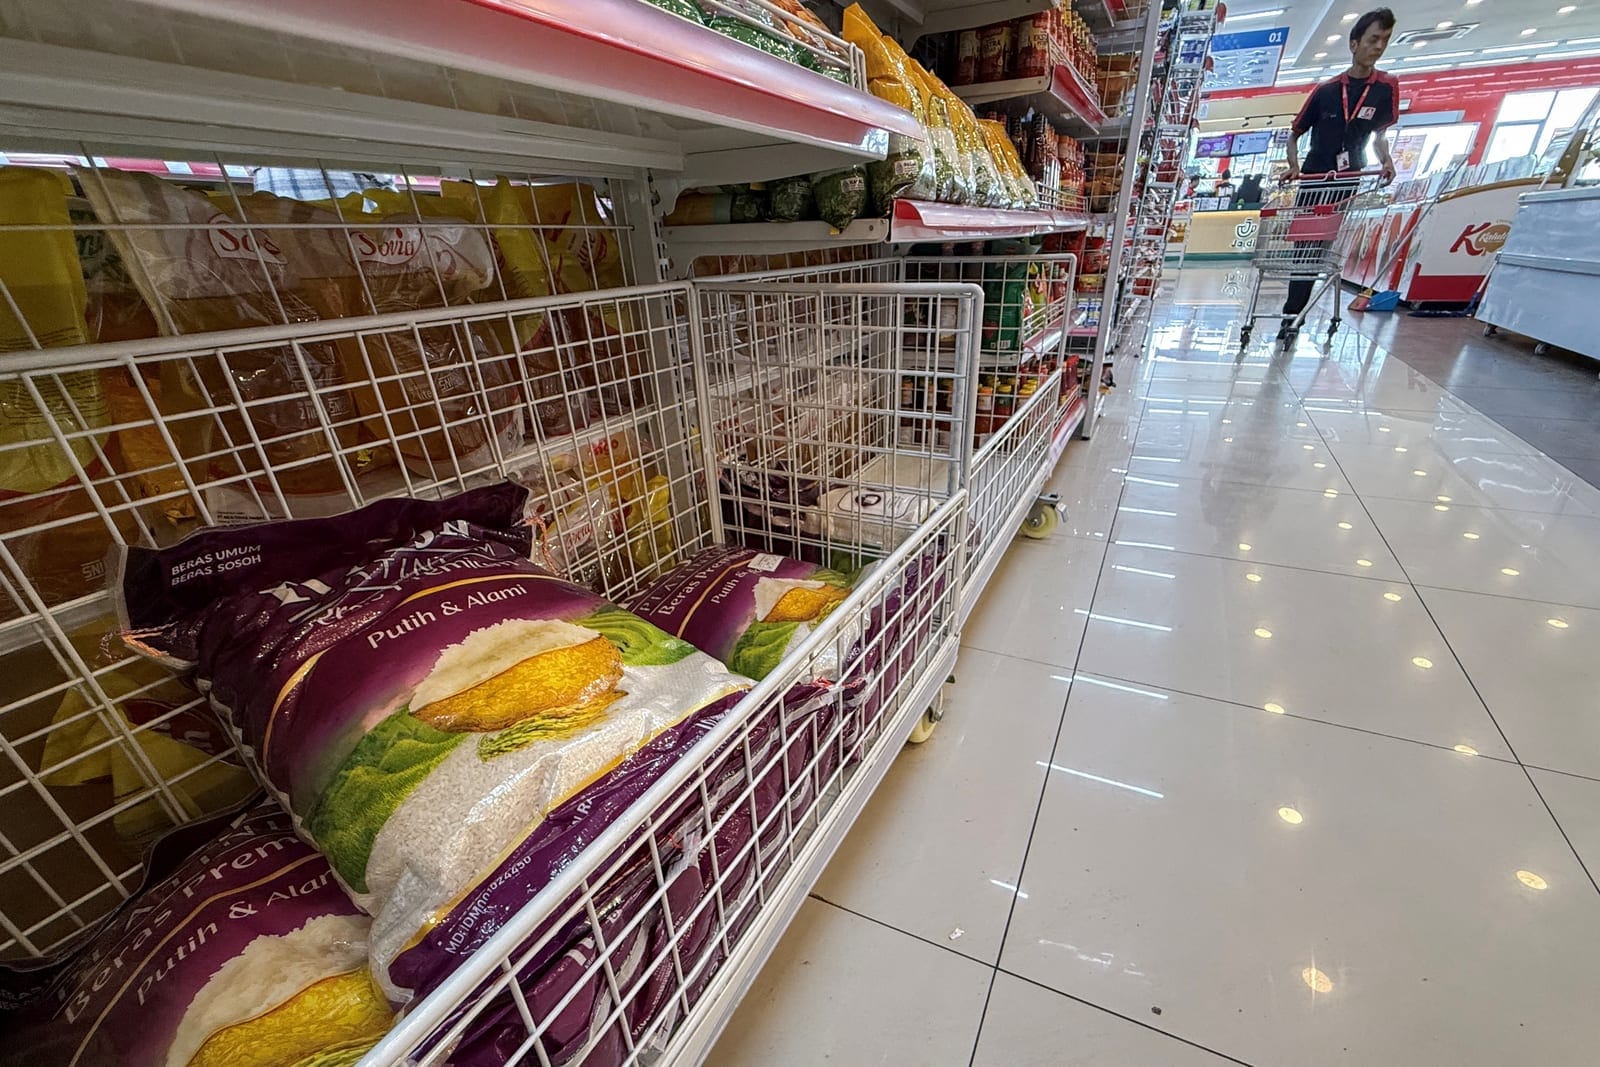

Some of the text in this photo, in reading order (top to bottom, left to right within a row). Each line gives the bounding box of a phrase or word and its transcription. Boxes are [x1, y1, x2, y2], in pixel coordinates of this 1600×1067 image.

[1268, 31, 1282, 43] 01
[81, 562, 105, 579] SNI
[171, 544, 261, 576] BERAS UMUM
[171, 554, 262, 586] BERAS SOSOH
[658, 580, 701, 615] Beras
[367, 584, 528, 649] Putih & Alami
[64, 908, 173, 1025] Beras
[136, 920, 218, 1006] Putih
[228, 900, 258, 922] &
